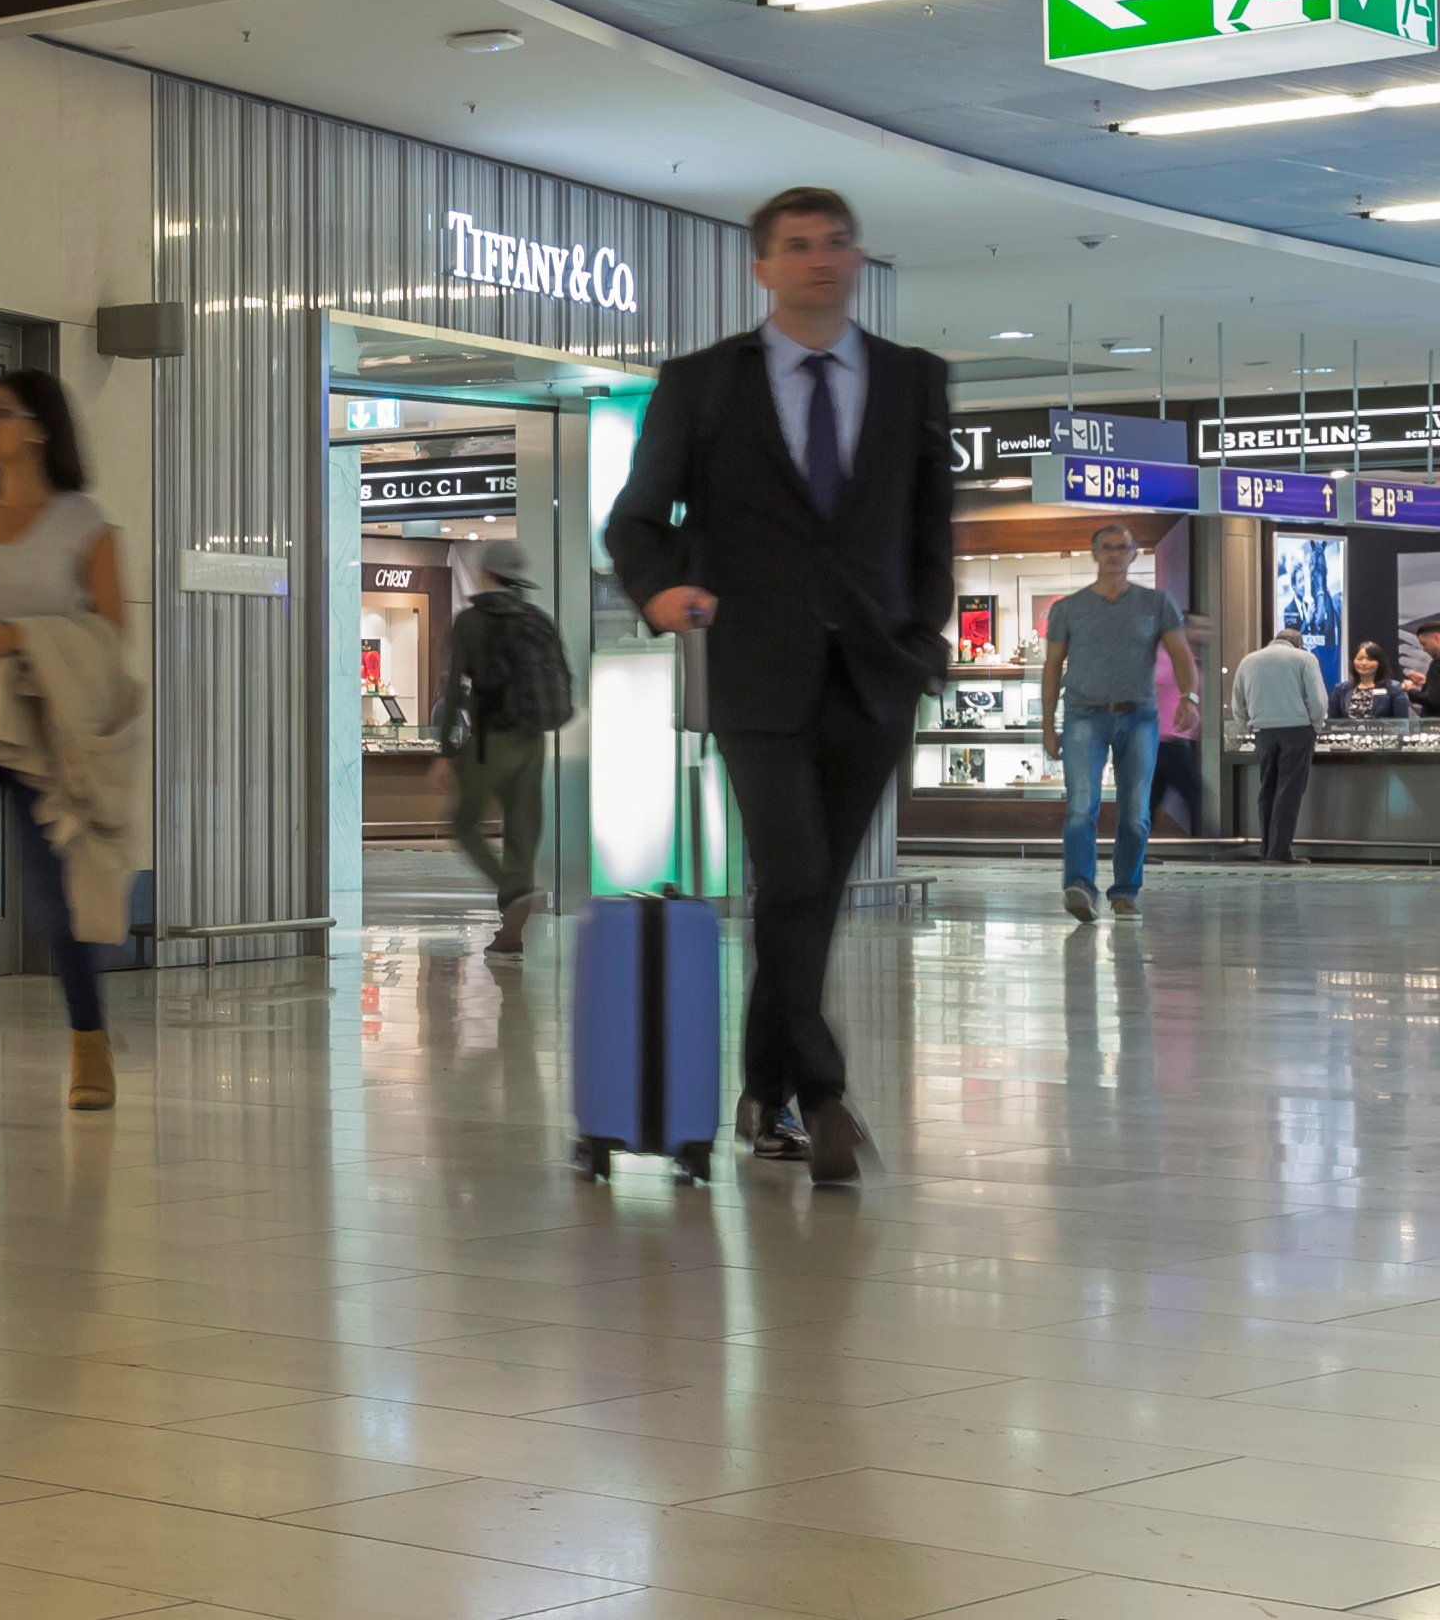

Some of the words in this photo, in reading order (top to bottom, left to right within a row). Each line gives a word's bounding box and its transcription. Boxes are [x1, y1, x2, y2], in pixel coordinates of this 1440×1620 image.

[1219, 425, 1371, 449] BREITLING
[382, 478, 462, 499] GUCCI
[1104, 466, 1114, 498] B
[1254, 477, 1264, 508] B
[1386, 488, 1396, 517] B
[375, 569, 413, 588] CHRIST
